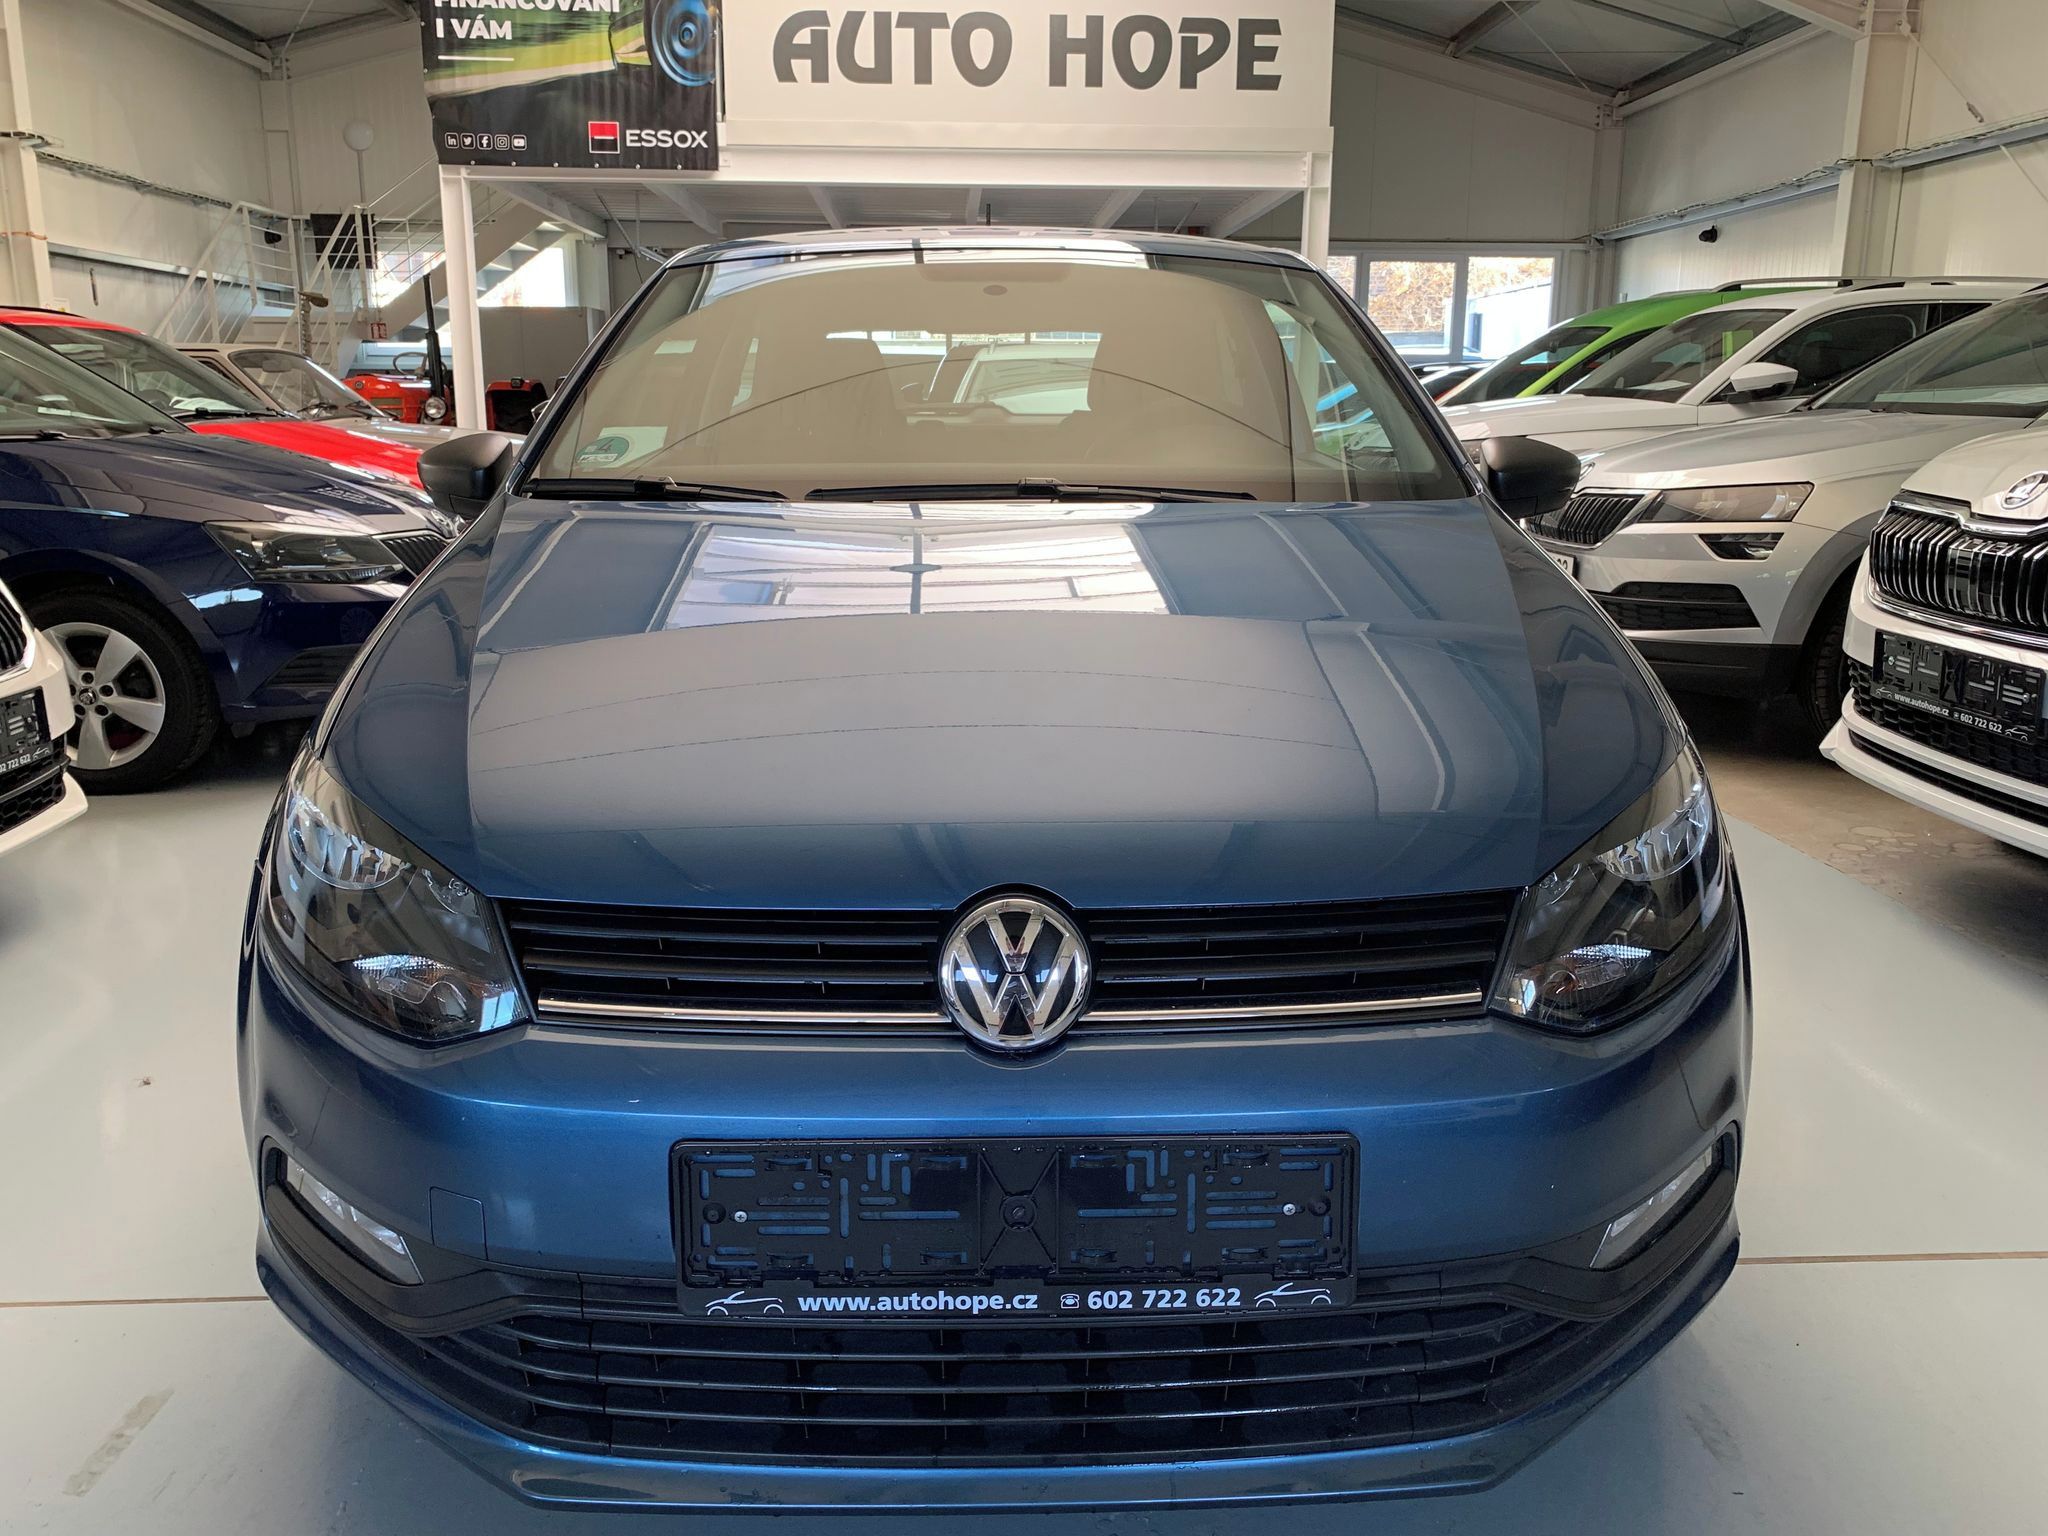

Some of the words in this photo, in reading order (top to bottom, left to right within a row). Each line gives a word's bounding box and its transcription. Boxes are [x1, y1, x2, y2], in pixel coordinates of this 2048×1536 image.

[435, 18, 444, 38] I
[450, 13, 513, 40] VÁM
[772, 10, 1013, 88] AUTO
[1048, 14, 1282, 91] HOPE
[625, 129, 709, 149] ESSOX
[1894, 693, 1950, 717] www.autohope.cz
[1960, 713, 1973, 725] 602
[1974, 717, 1988, 729] 722
[1988, 721, 2003, 733] 622
[797, 1290, 1038, 1315] www.autohope.cz
[1087, 1290, 1133, 1310] 602
[1142, 1289, 1188, 1309] 722
[1195, 1287, 1241, 1308] 622
